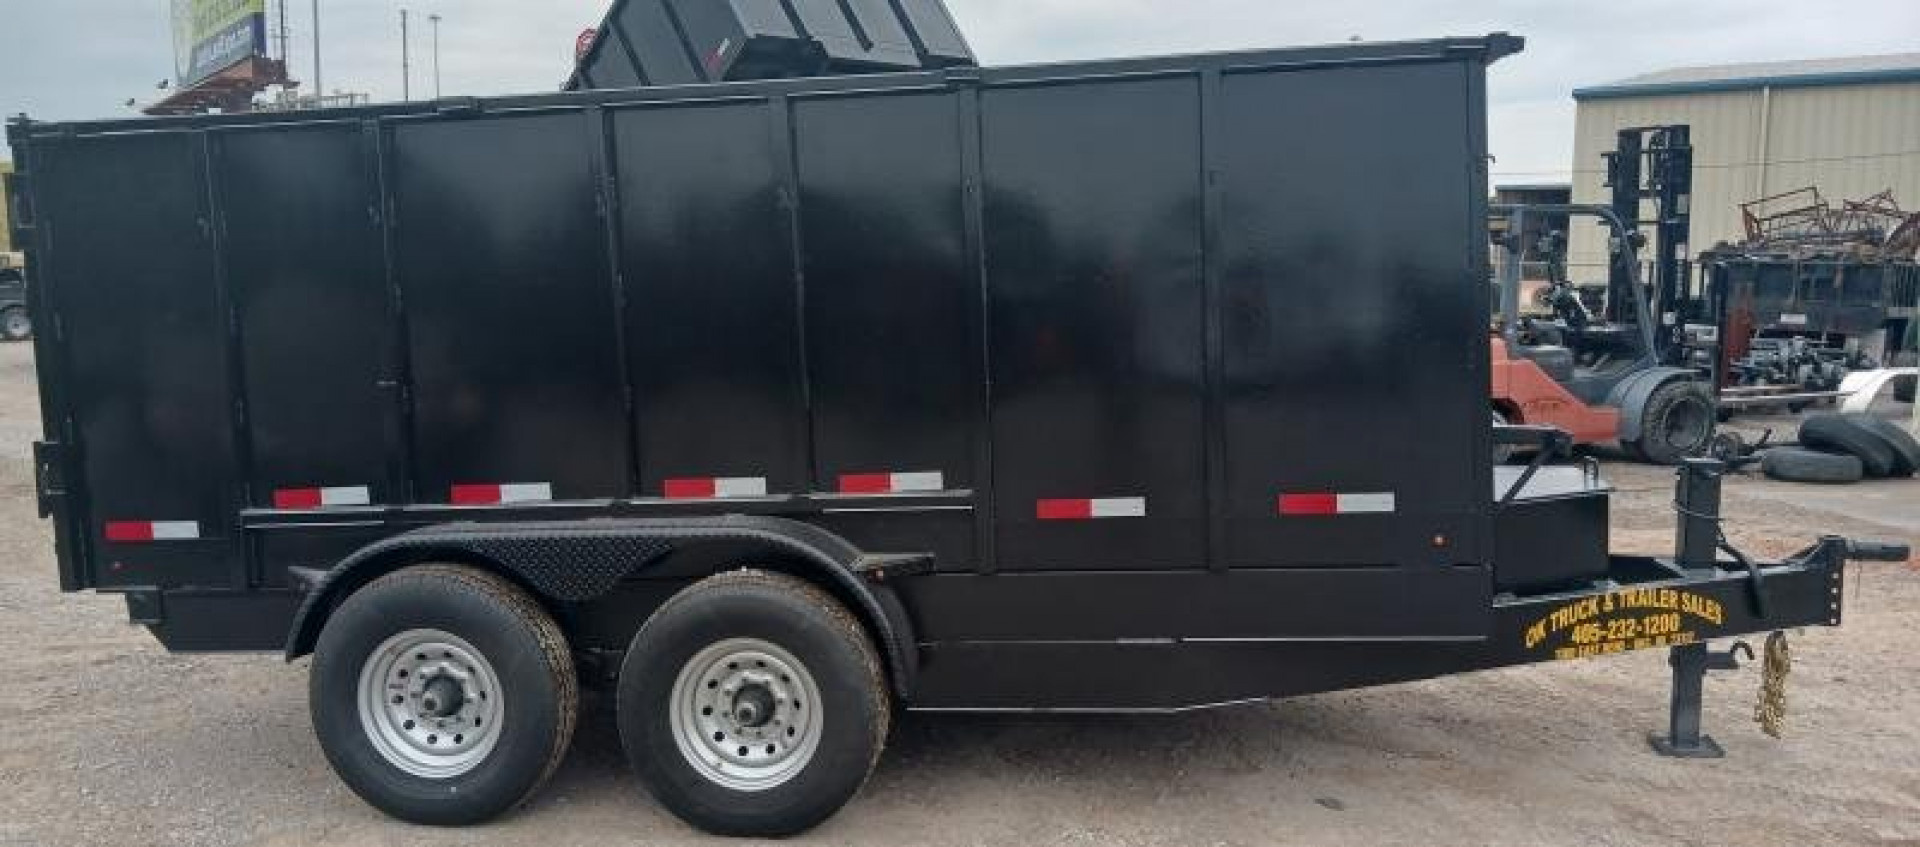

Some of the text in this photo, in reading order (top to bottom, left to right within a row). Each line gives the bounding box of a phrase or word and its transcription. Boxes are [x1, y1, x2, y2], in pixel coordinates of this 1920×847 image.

[1549, 598, 1599, 632] TRUCK
[1619, 588, 1679, 610] TRAILER
[1681, 592, 1722, 625] SALES
